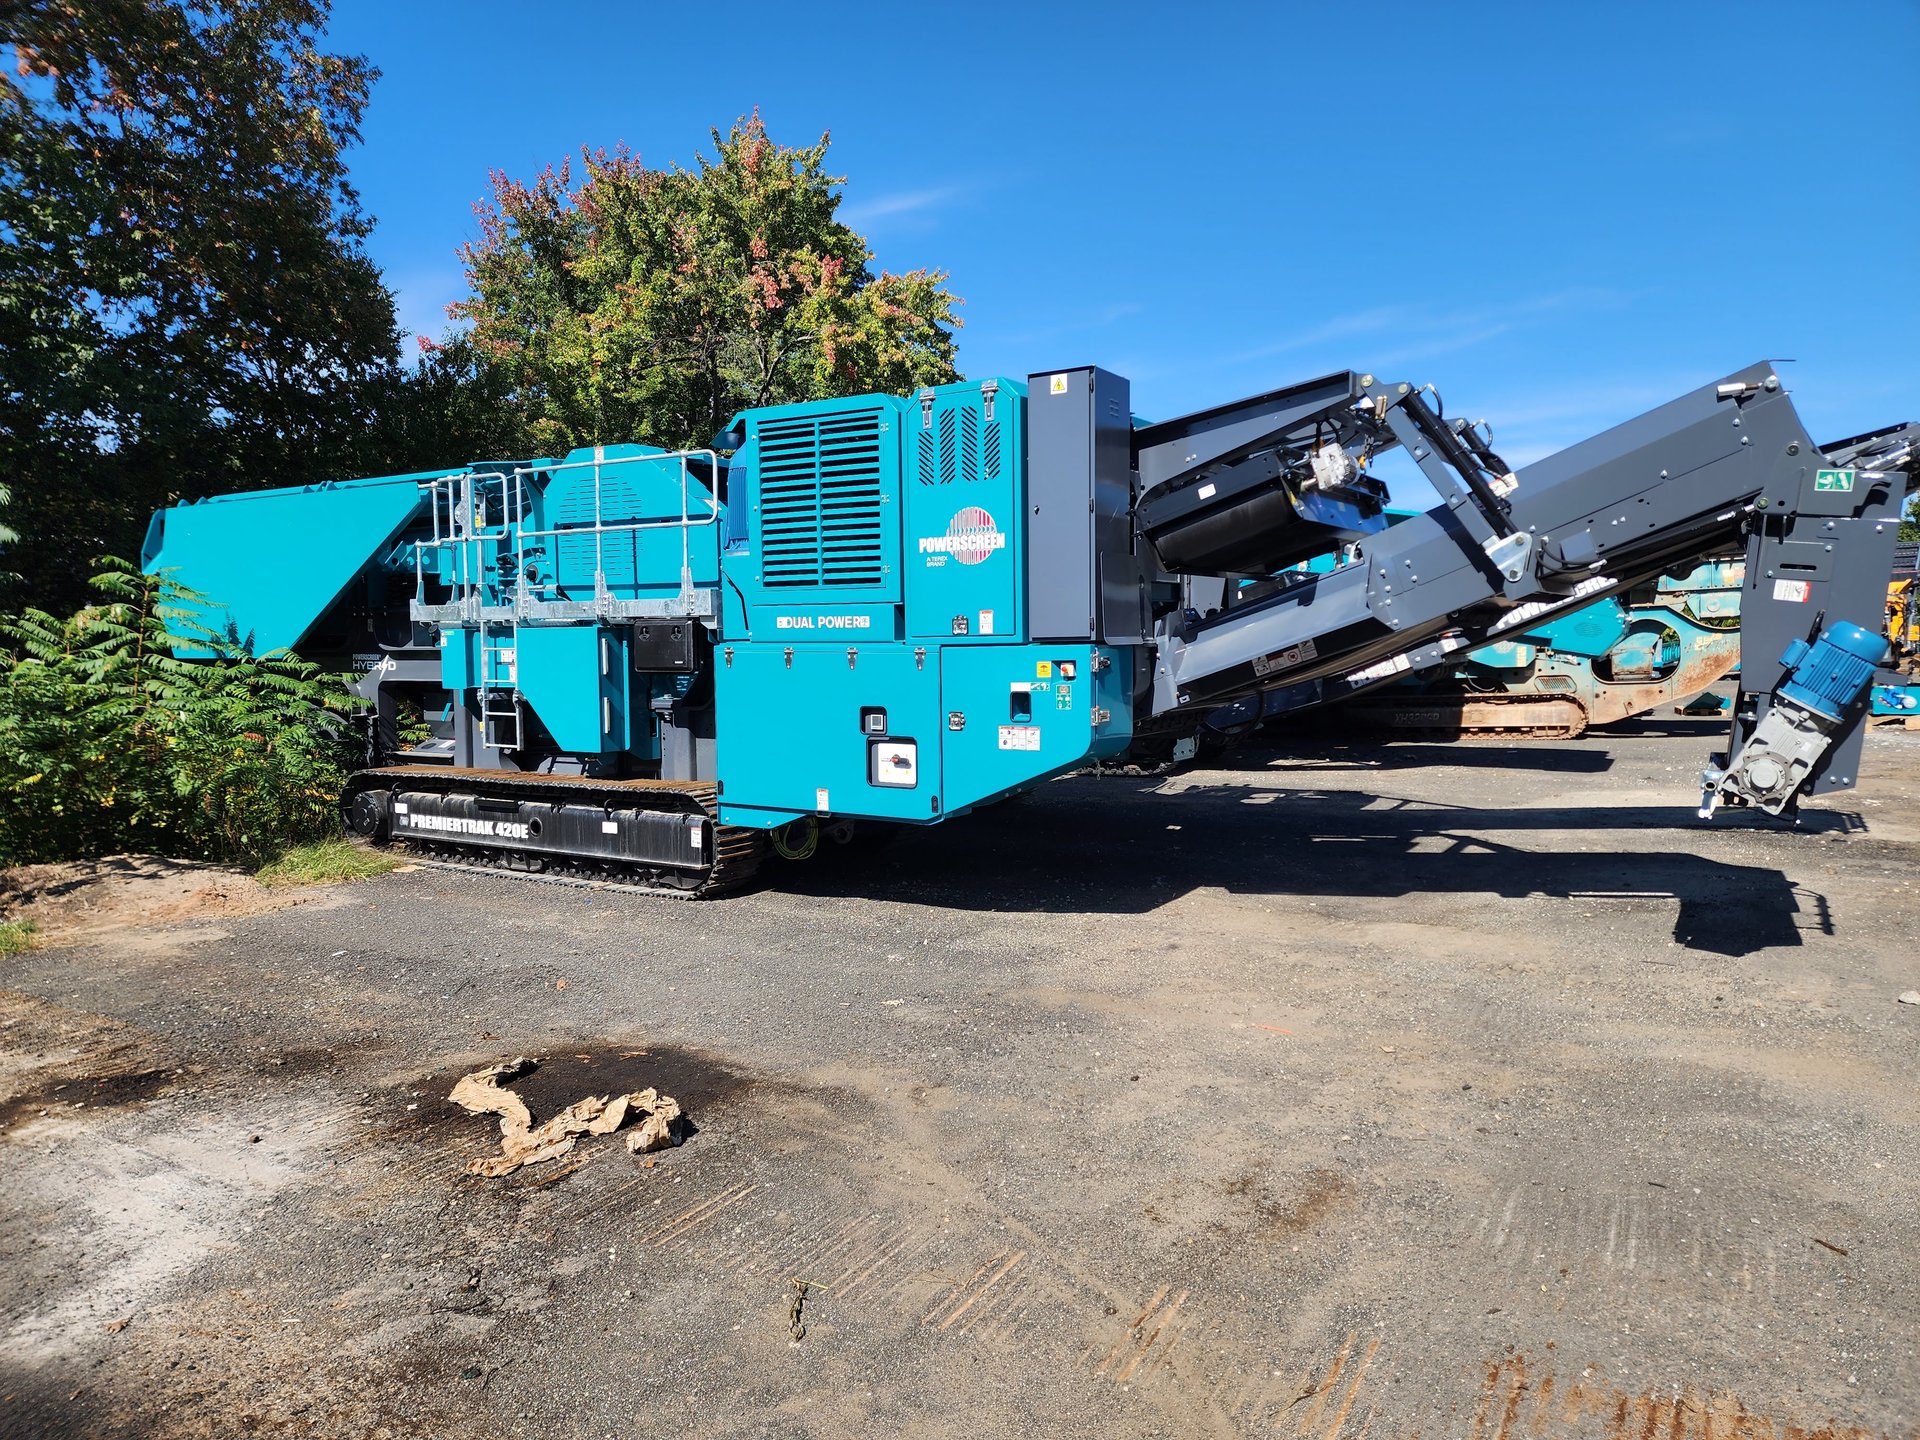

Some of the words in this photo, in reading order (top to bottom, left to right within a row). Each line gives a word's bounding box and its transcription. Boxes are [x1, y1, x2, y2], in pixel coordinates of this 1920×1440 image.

[919, 533, 1005, 553] POWERSCREEN
[786, 616, 815, 628] DUAL
[818, 616, 861, 628] POWER
[410, 814, 494, 835] PREMIERTRAK
[495, 822, 528, 838] 420E
